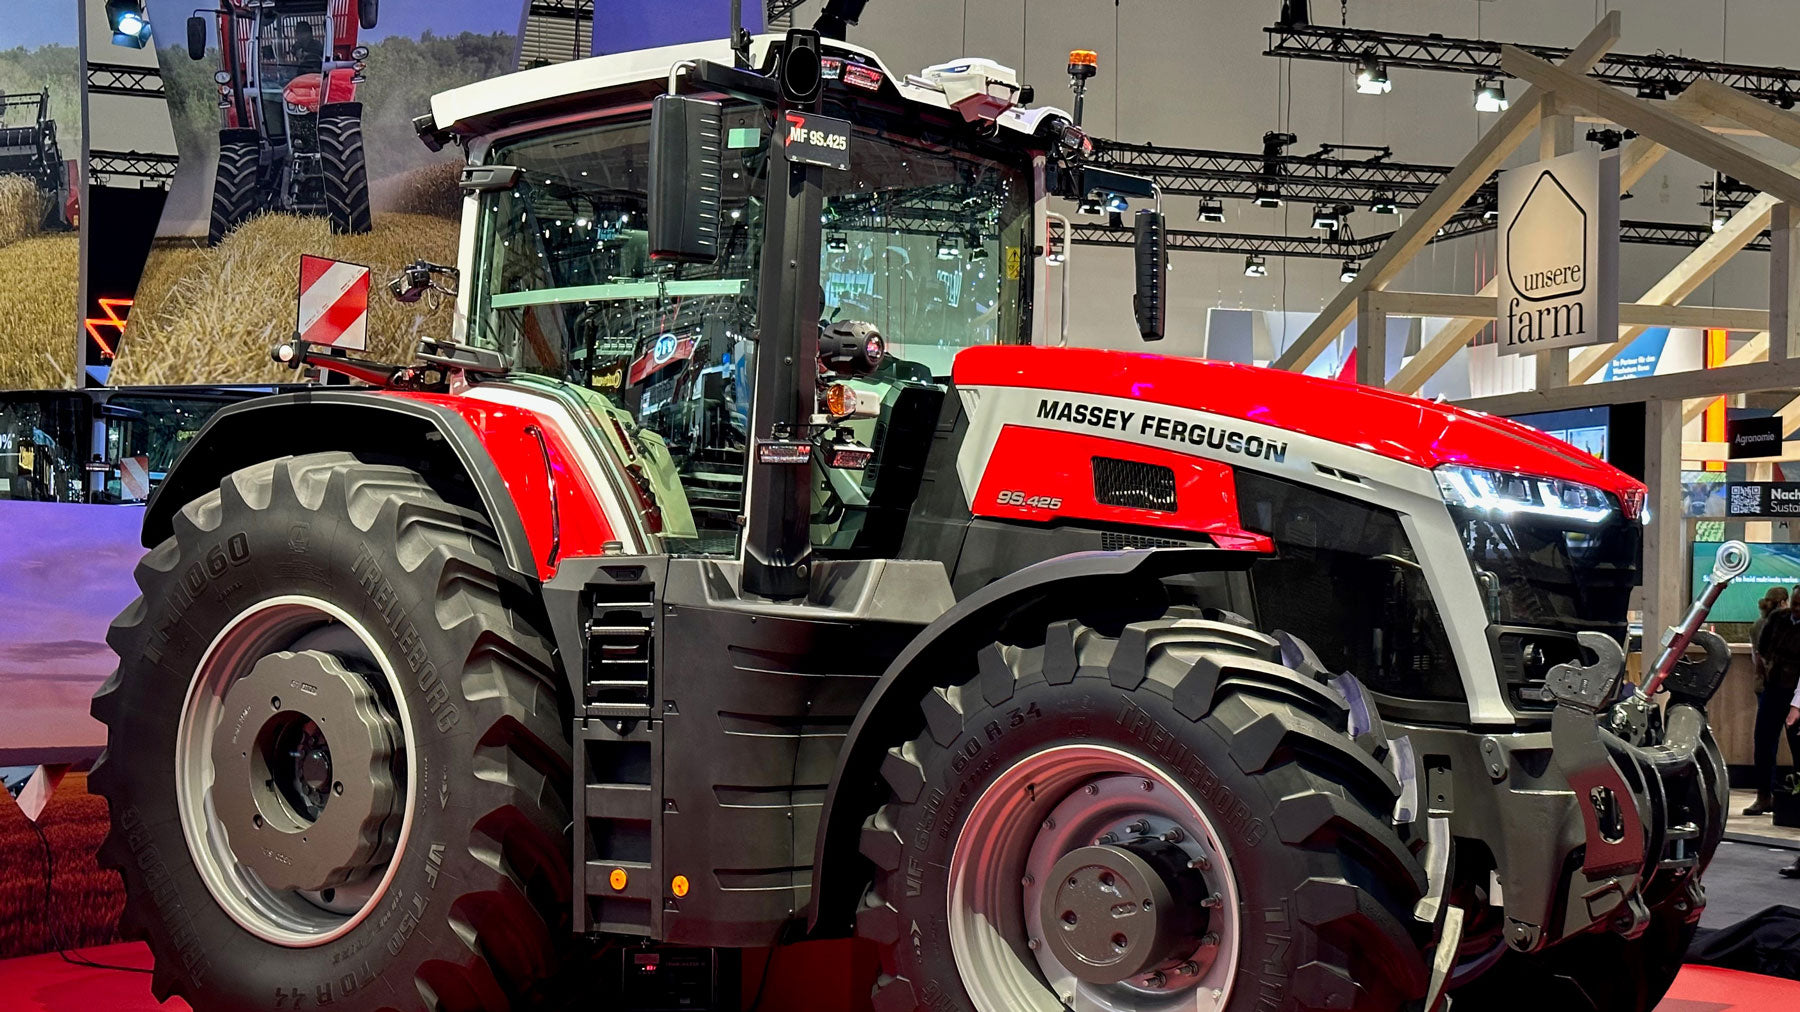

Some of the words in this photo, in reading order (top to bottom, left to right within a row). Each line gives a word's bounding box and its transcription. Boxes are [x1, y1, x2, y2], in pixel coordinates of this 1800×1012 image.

[790, 126, 808, 143] MF
[809, 130, 847, 151] 9S.425
[1523, 264, 1581, 292] unsere
[1507, 297, 1586, 346] farm
[1036, 399, 1136, 432] MASSEY
[1140, 414, 1288, 464] FERGUSON
[1735, 431, 1775, 446] Agronomie
[996, 490, 1063, 510] 9S.425
[1770, 488, 1800, 500] Nach
[141, 530, 251, 665] TM1060
[350, 539, 462, 735] TRELLEBORG
[1112, 693, 1269, 848] TRELLEBORG
[905, 855, 925, 898] VF
[983, 718, 1005, 745] R
[1005, 701, 1043, 730] 34
[424, 841, 447, 889] VF
